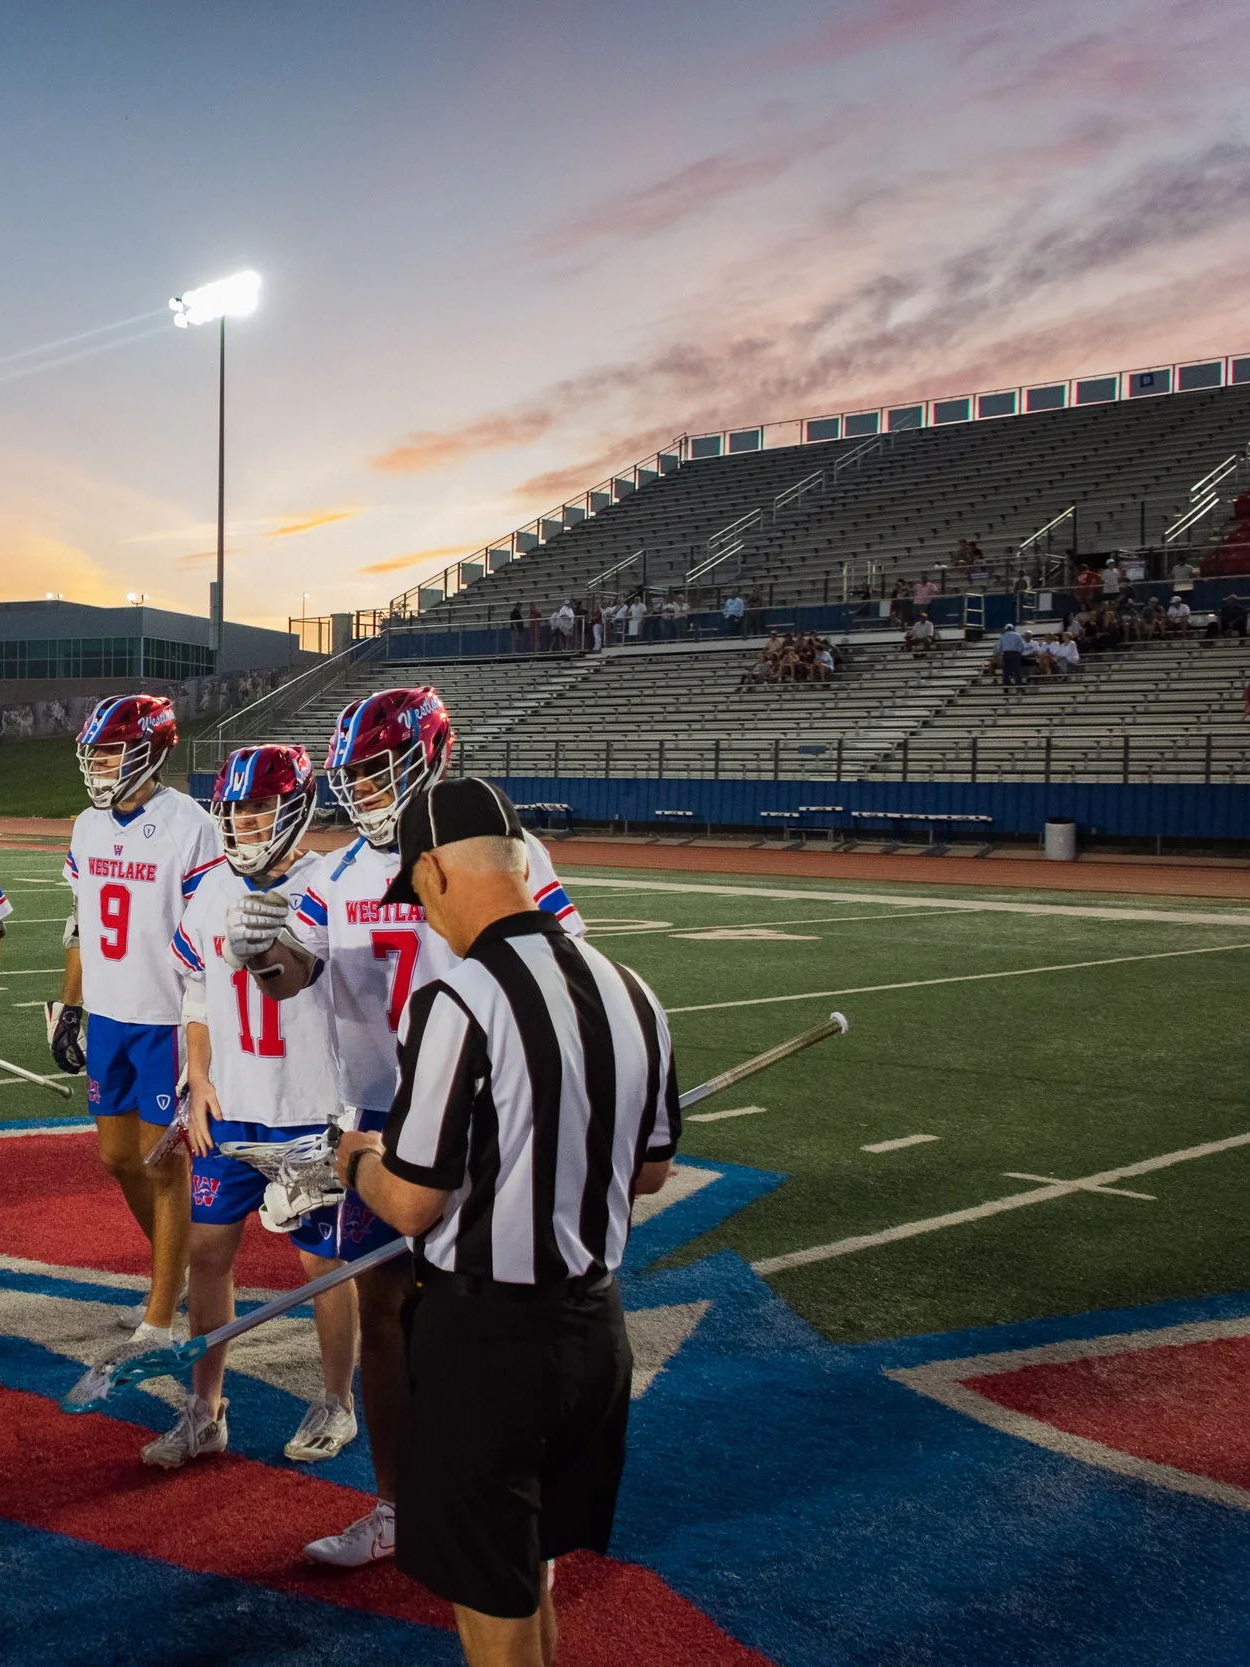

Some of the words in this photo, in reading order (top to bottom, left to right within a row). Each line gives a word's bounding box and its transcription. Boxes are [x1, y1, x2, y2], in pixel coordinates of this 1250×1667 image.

[88, 856, 157, 882] WESTLAKE
[100, 881, 132, 962] 9
[346, 899, 429, 925] WESTLA
[230, 966, 287, 1059] 11
[369, 928, 421, 1034] 7
